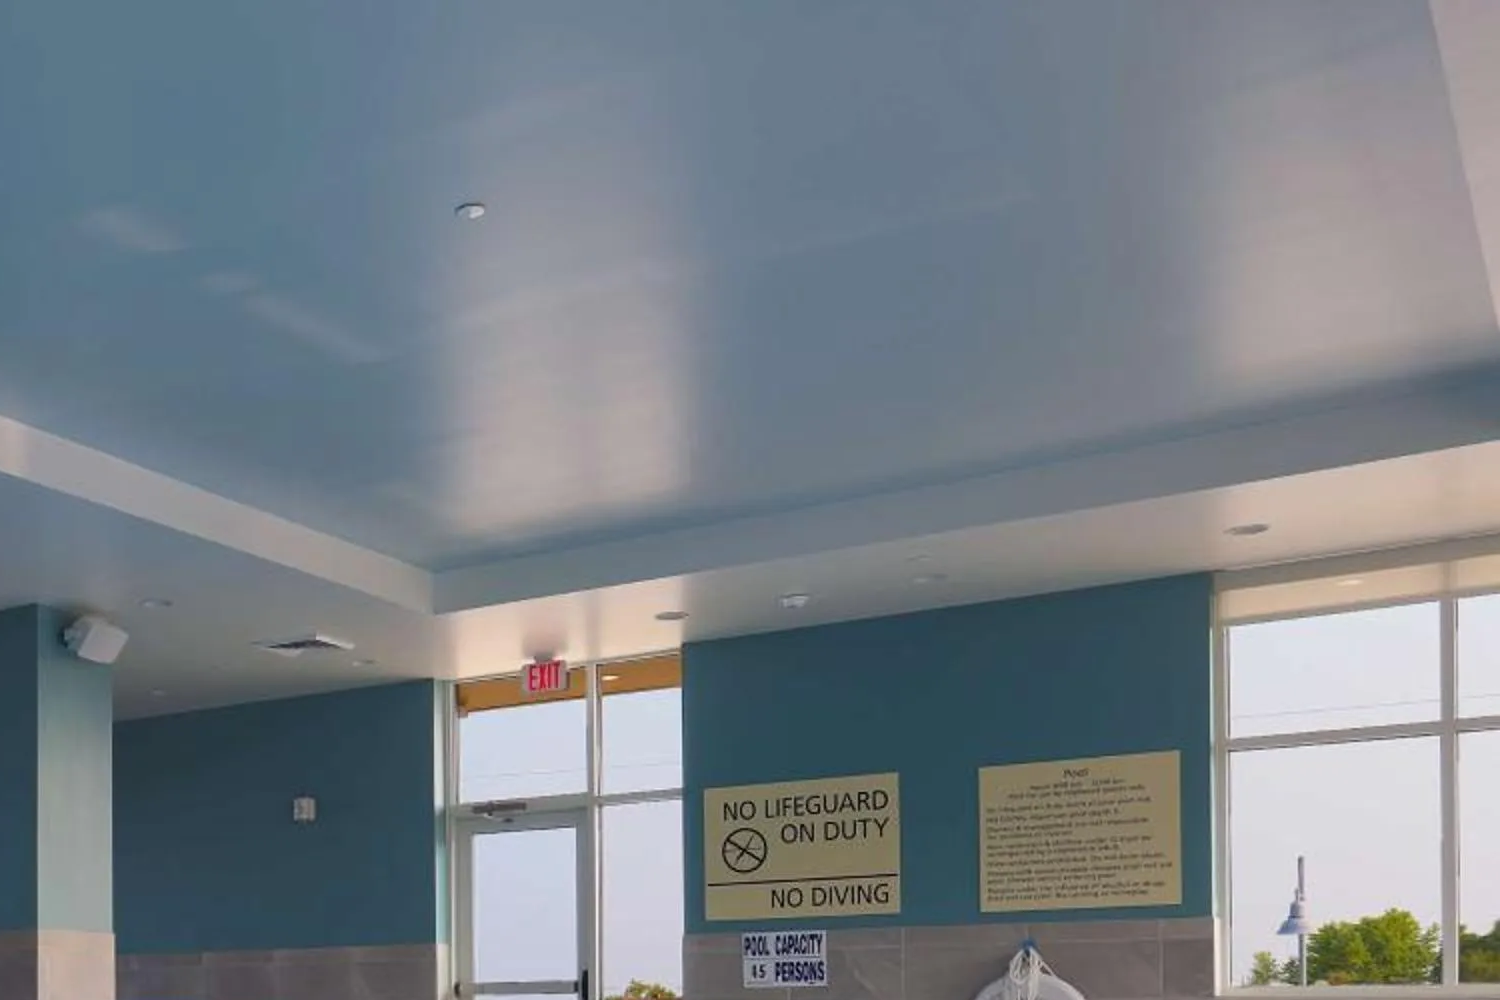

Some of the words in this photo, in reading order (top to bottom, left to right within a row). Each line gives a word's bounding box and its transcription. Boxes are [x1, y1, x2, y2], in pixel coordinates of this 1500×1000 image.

[723, 800, 757, 821] NO
[765, 790, 889, 818] LIFEGUARD
[781, 823, 815, 844] ON
[824, 817, 890, 841] DUTY
[771, 887, 804, 909] NO
[812, 883, 889, 907] DIVING
[744, 935, 770, 956] POOL
[775, 933, 823, 955] CAPACITY
[752, 964, 766, 979] 15
[775, 961, 825, 982] PERSONS
